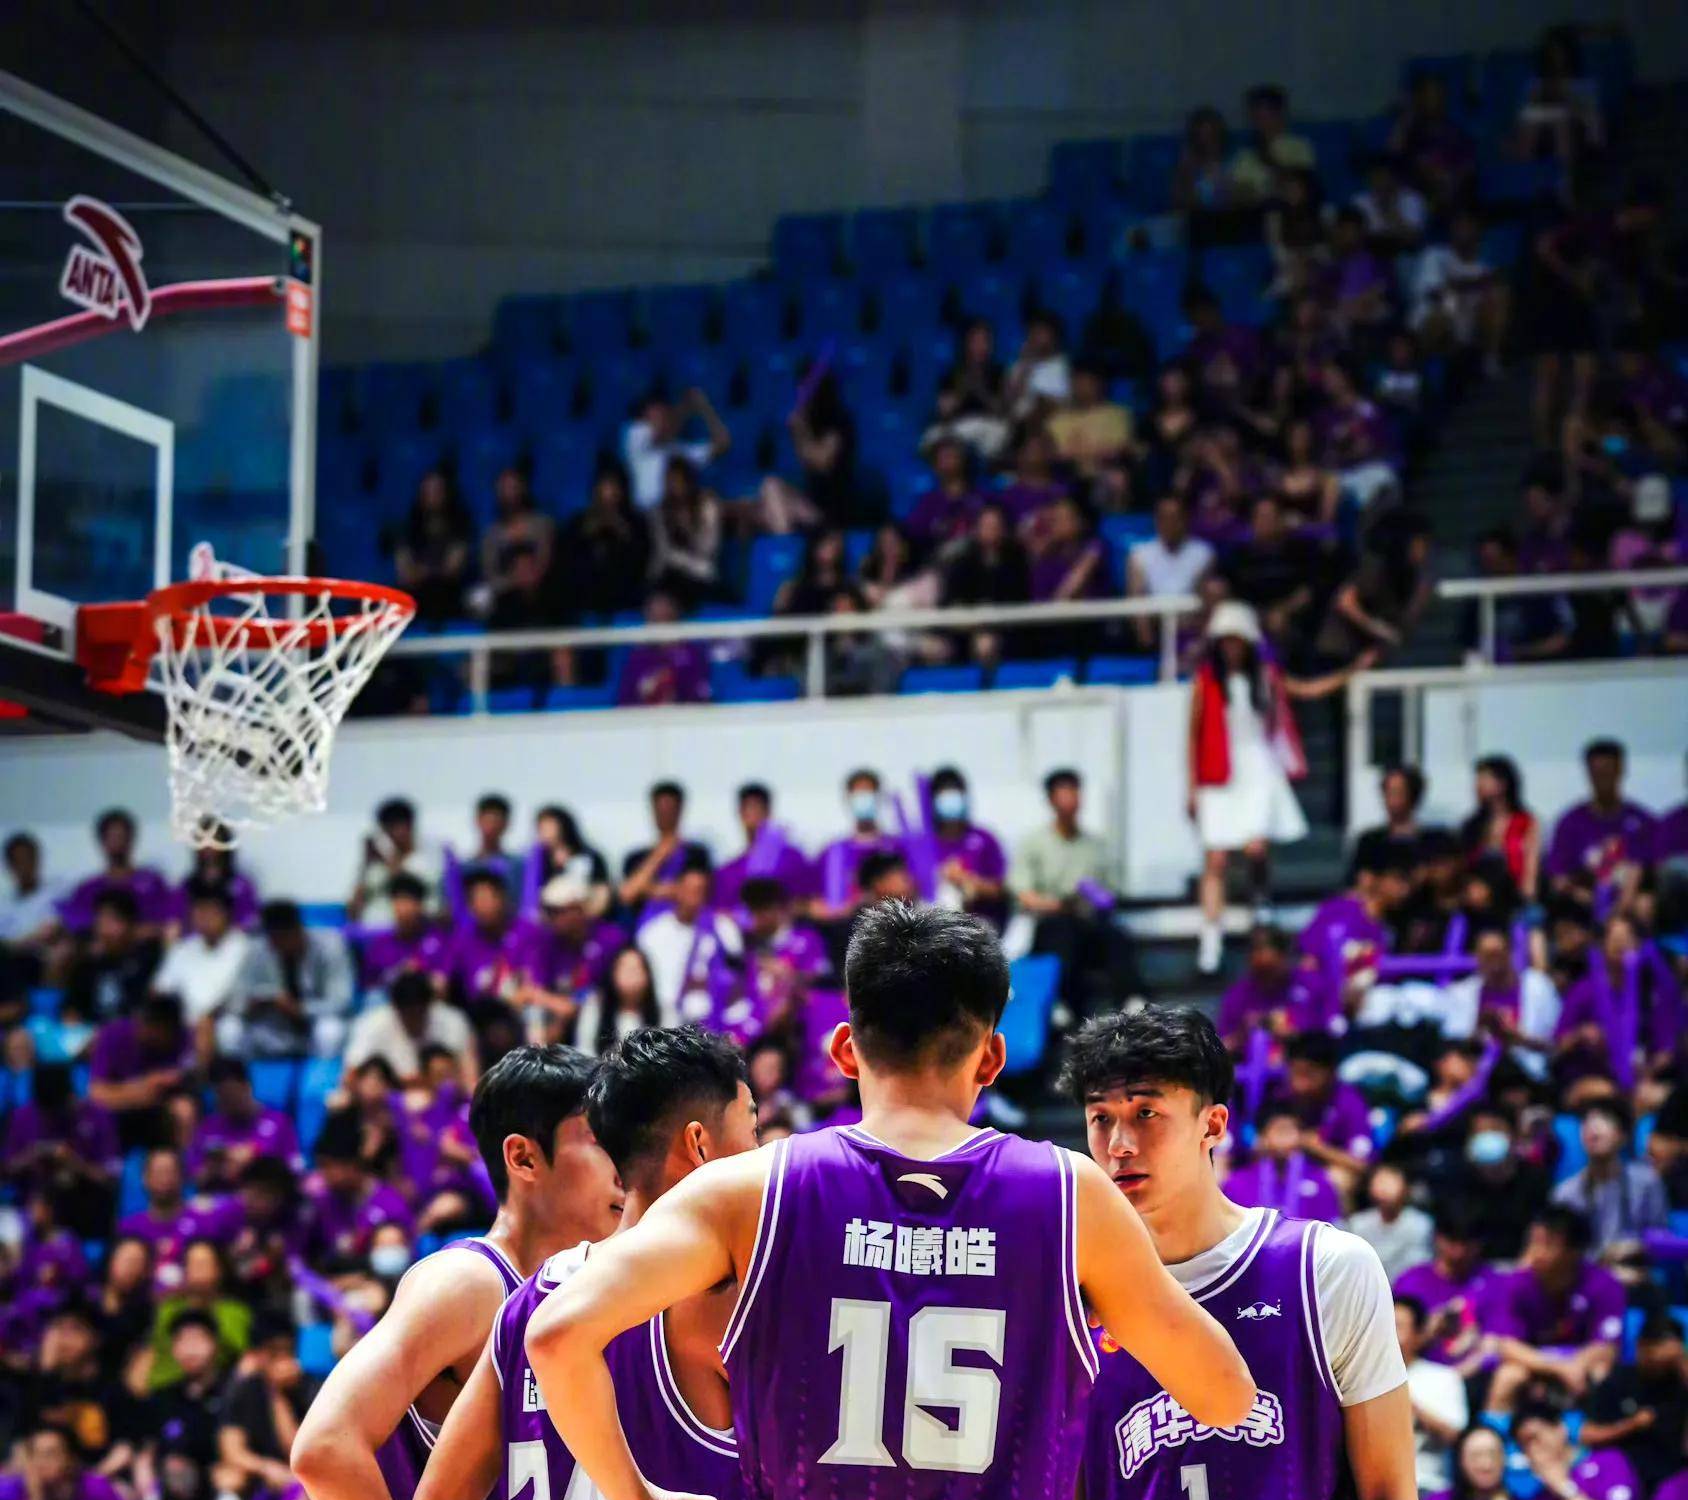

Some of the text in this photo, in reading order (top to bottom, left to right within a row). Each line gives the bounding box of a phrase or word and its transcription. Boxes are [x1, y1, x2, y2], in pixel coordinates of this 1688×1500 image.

[66, 253, 116, 309] ANTA
[842, 1217, 997, 1277] 杨曦皓
[1118, 1391, 1282, 1477] 清华学
